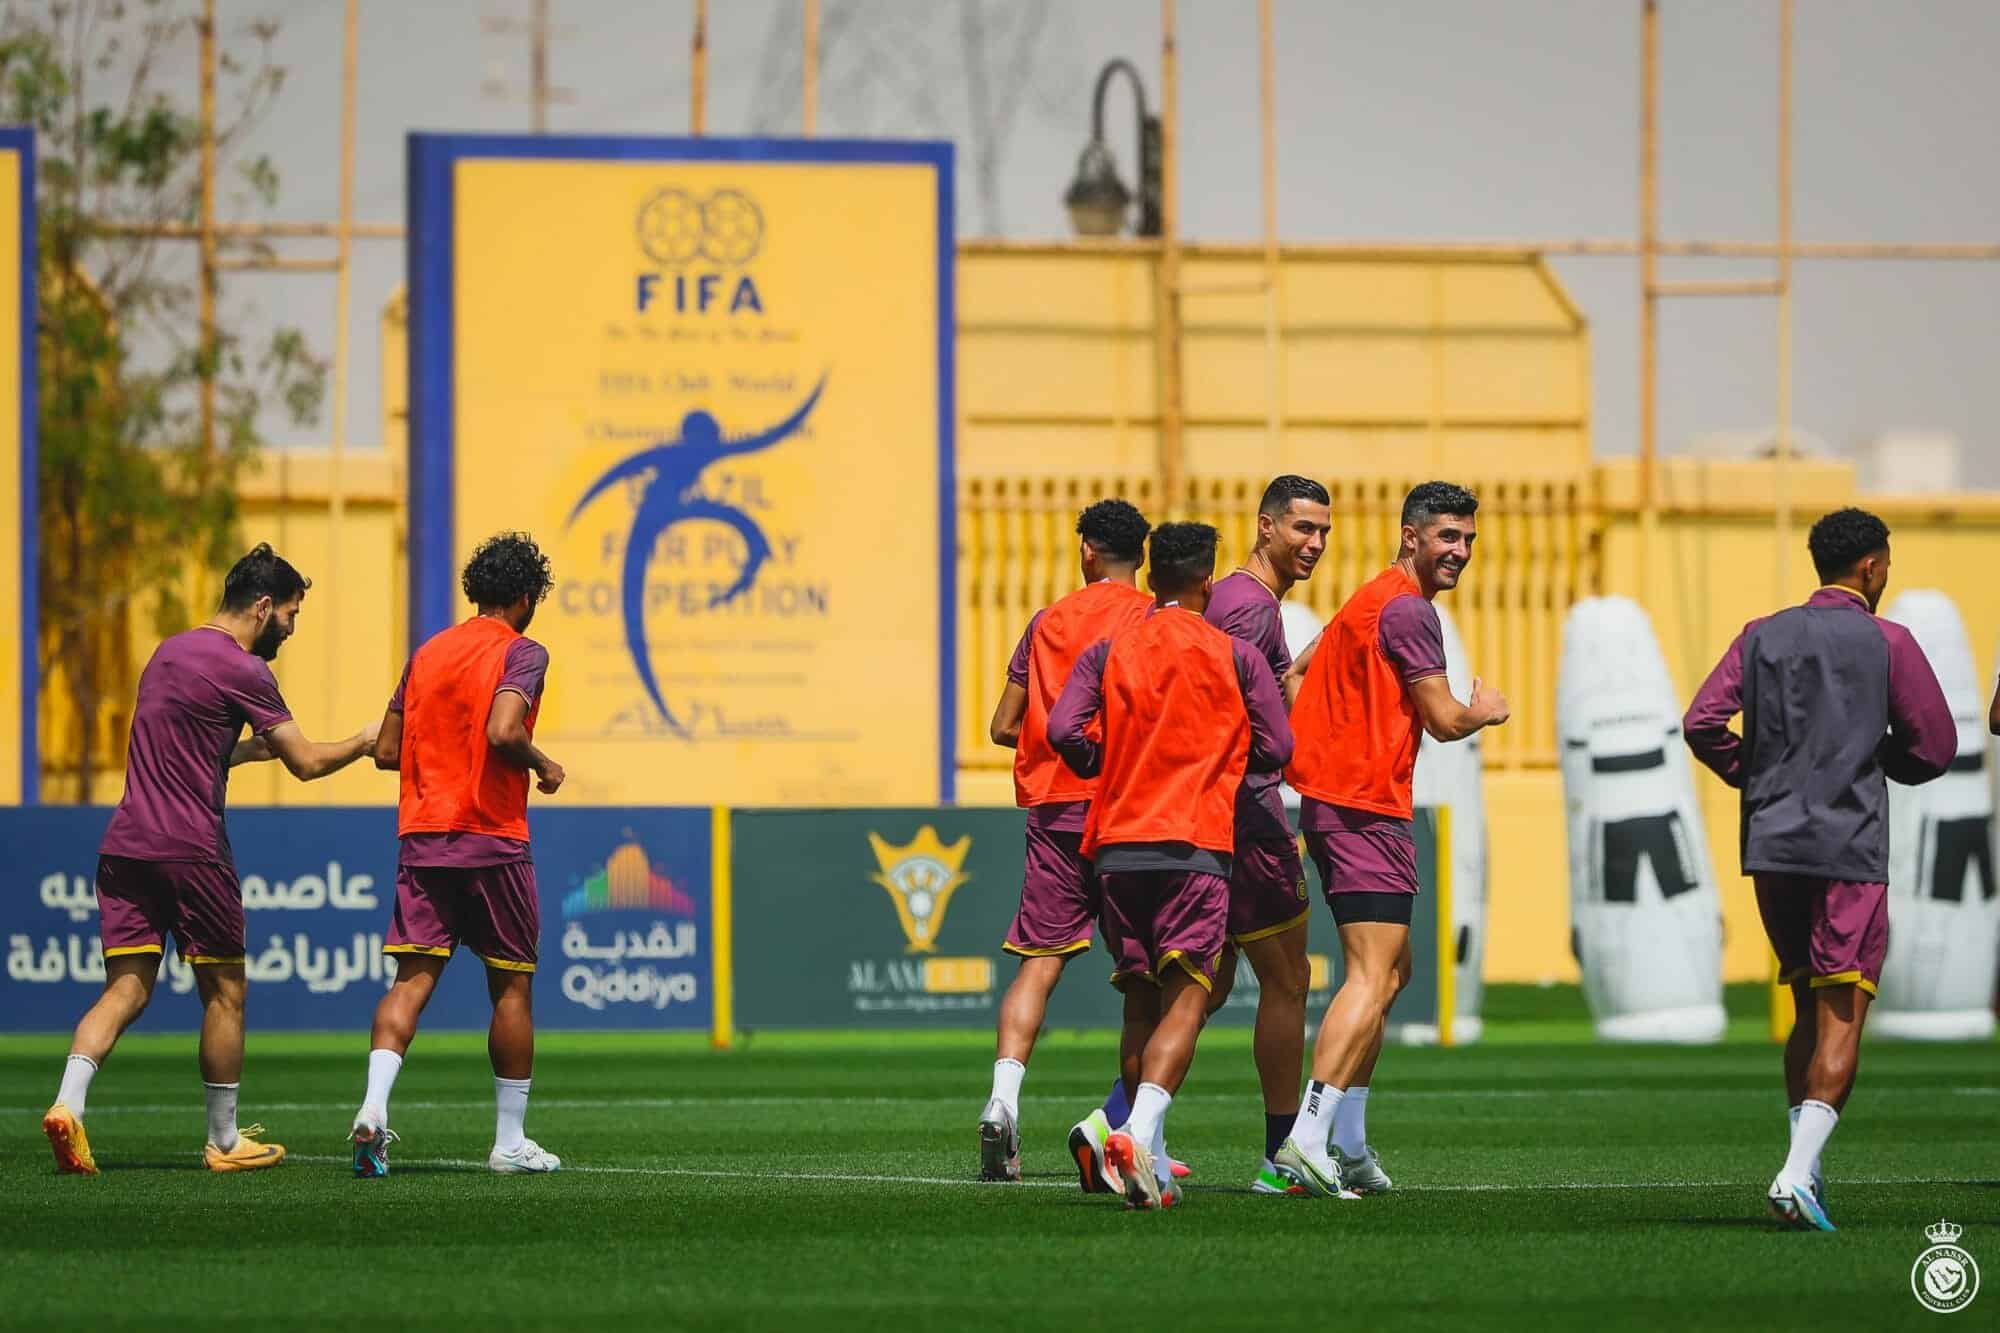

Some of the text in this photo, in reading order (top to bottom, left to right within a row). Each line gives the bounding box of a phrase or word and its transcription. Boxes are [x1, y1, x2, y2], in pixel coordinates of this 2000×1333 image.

[637, 274, 763, 314] FIFA
[561, 965, 697, 1010] Qiddiya
[1307, 1093, 1321, 1118] NIKE
